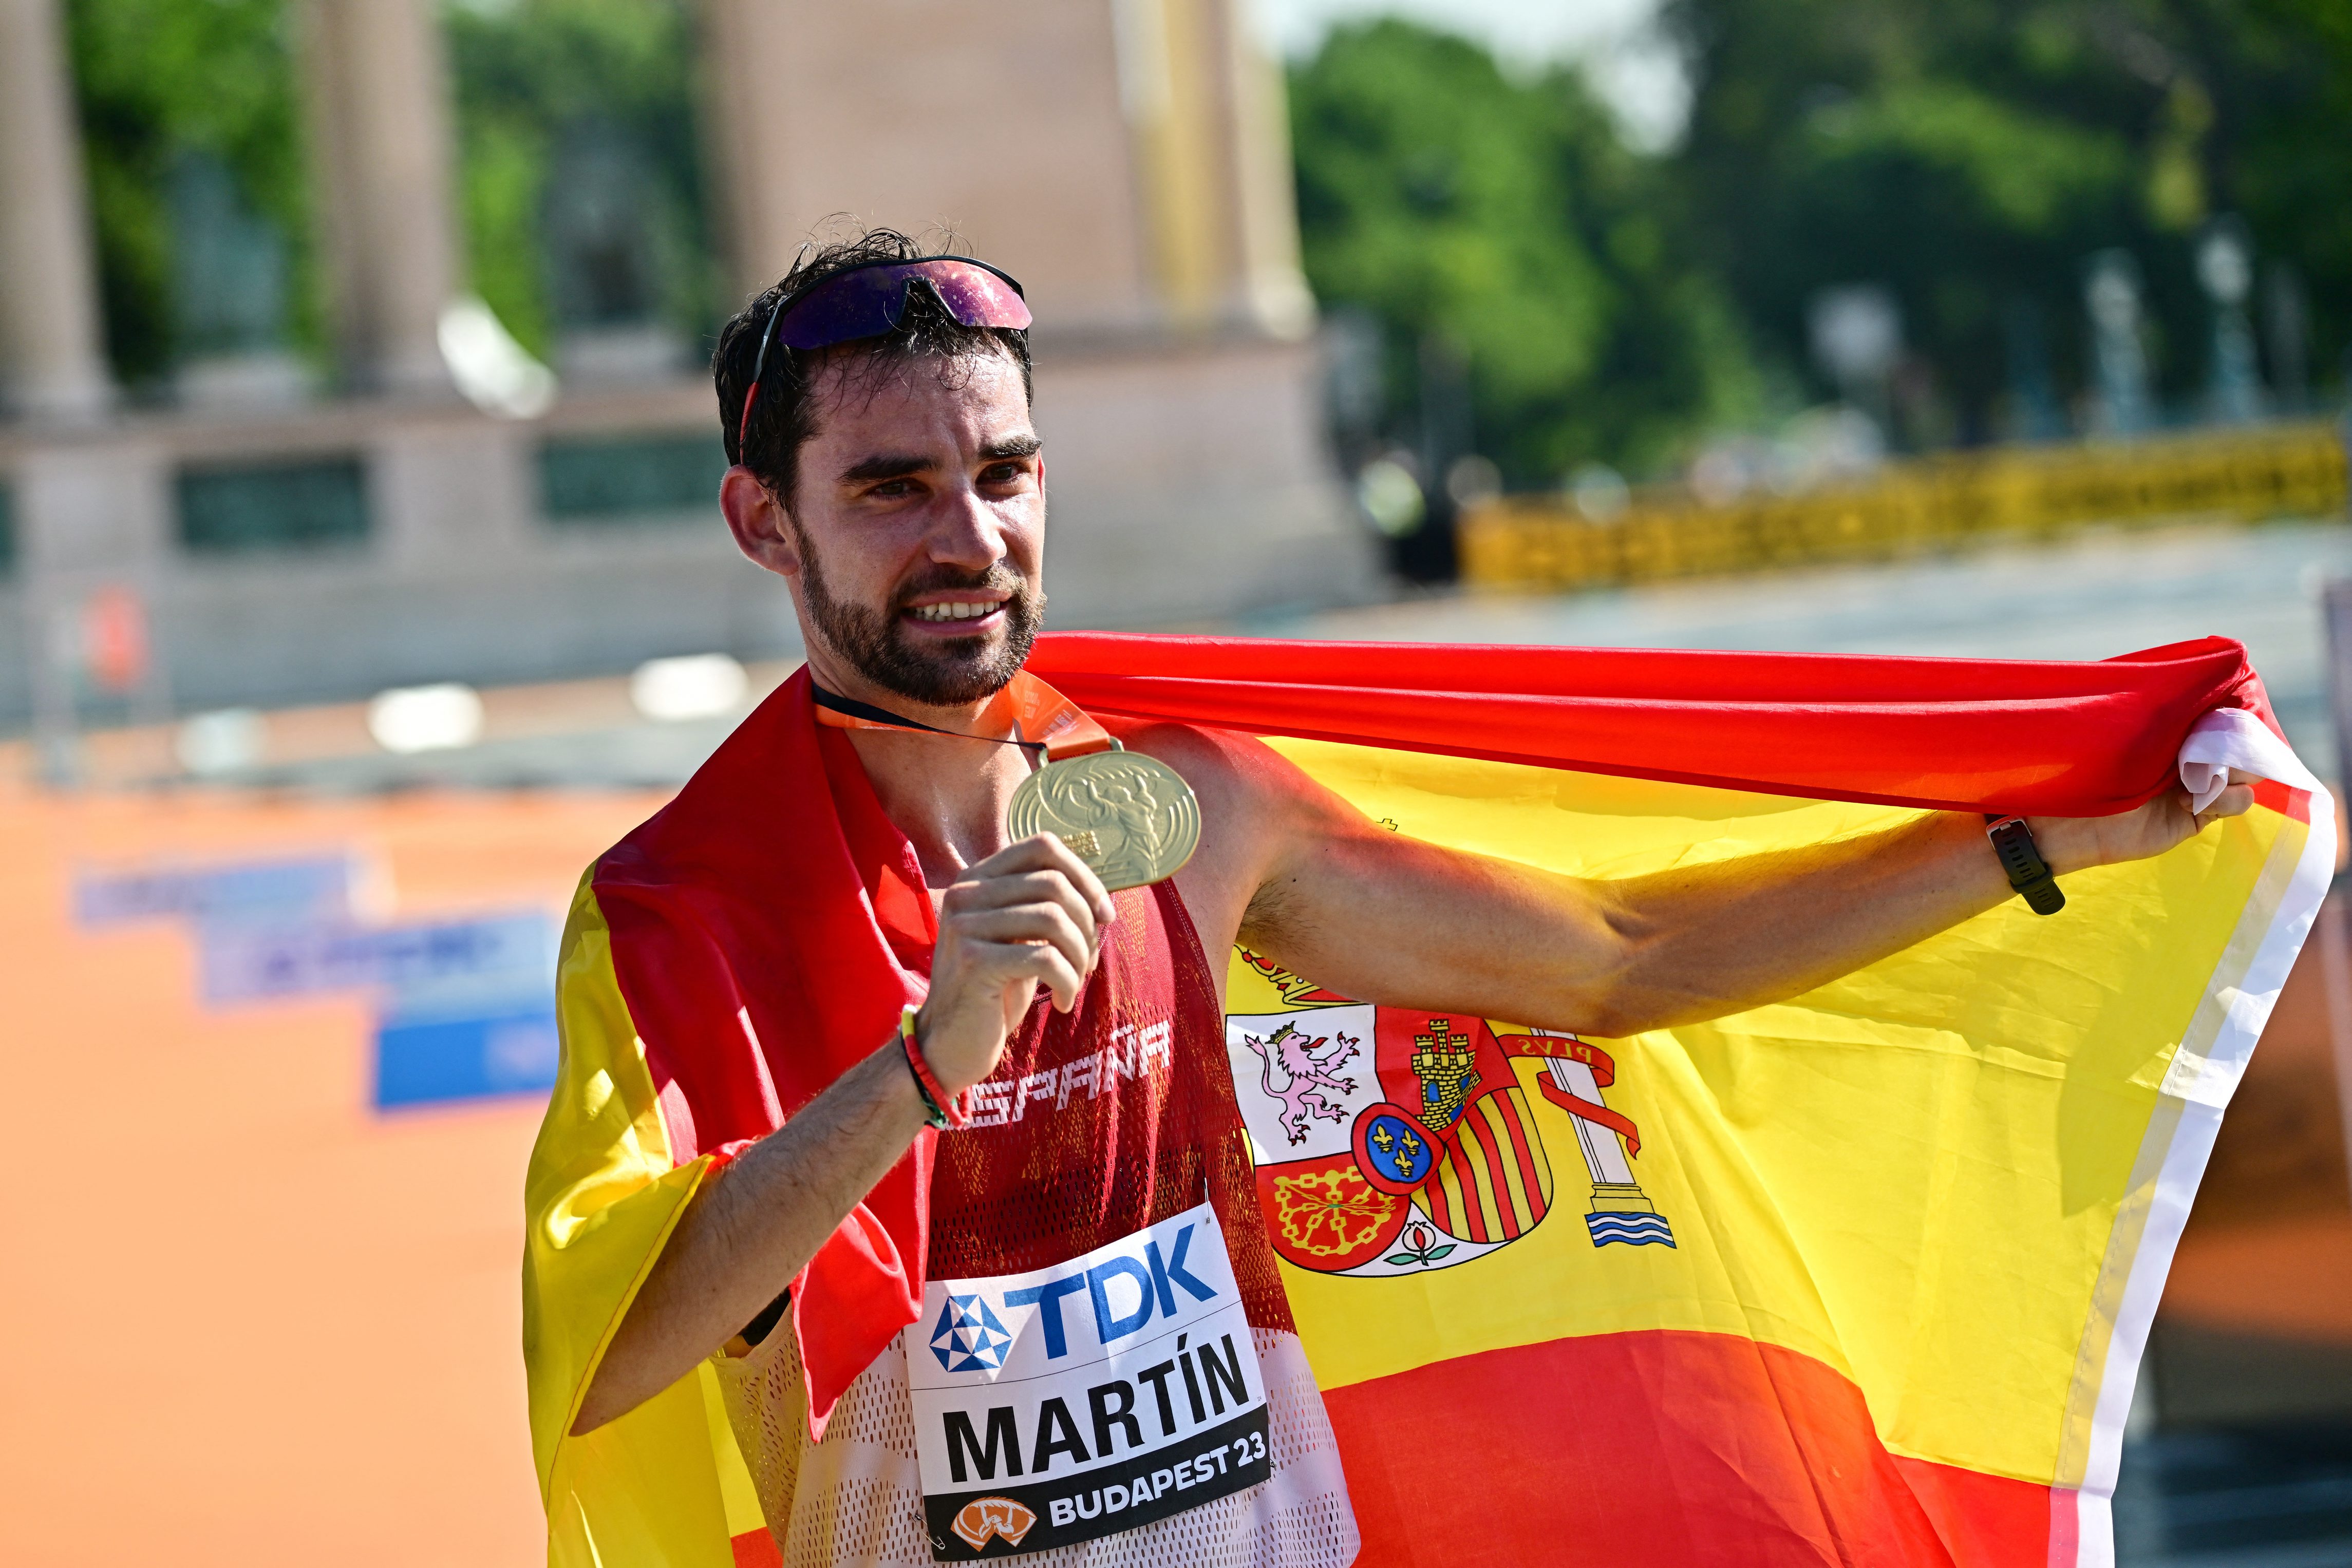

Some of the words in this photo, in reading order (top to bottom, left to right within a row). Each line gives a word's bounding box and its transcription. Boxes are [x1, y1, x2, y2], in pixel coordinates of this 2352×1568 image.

[941, 1020, 1170, 1130] SPAÑA
[1004, 1223, 1218, 1359] TDK
[943, 1333, 1250, 1483] MARTÍN
[1049, 1445, 1229, 1527] BUDAPEST
[1233, 1431, 1266, 1467] 23
